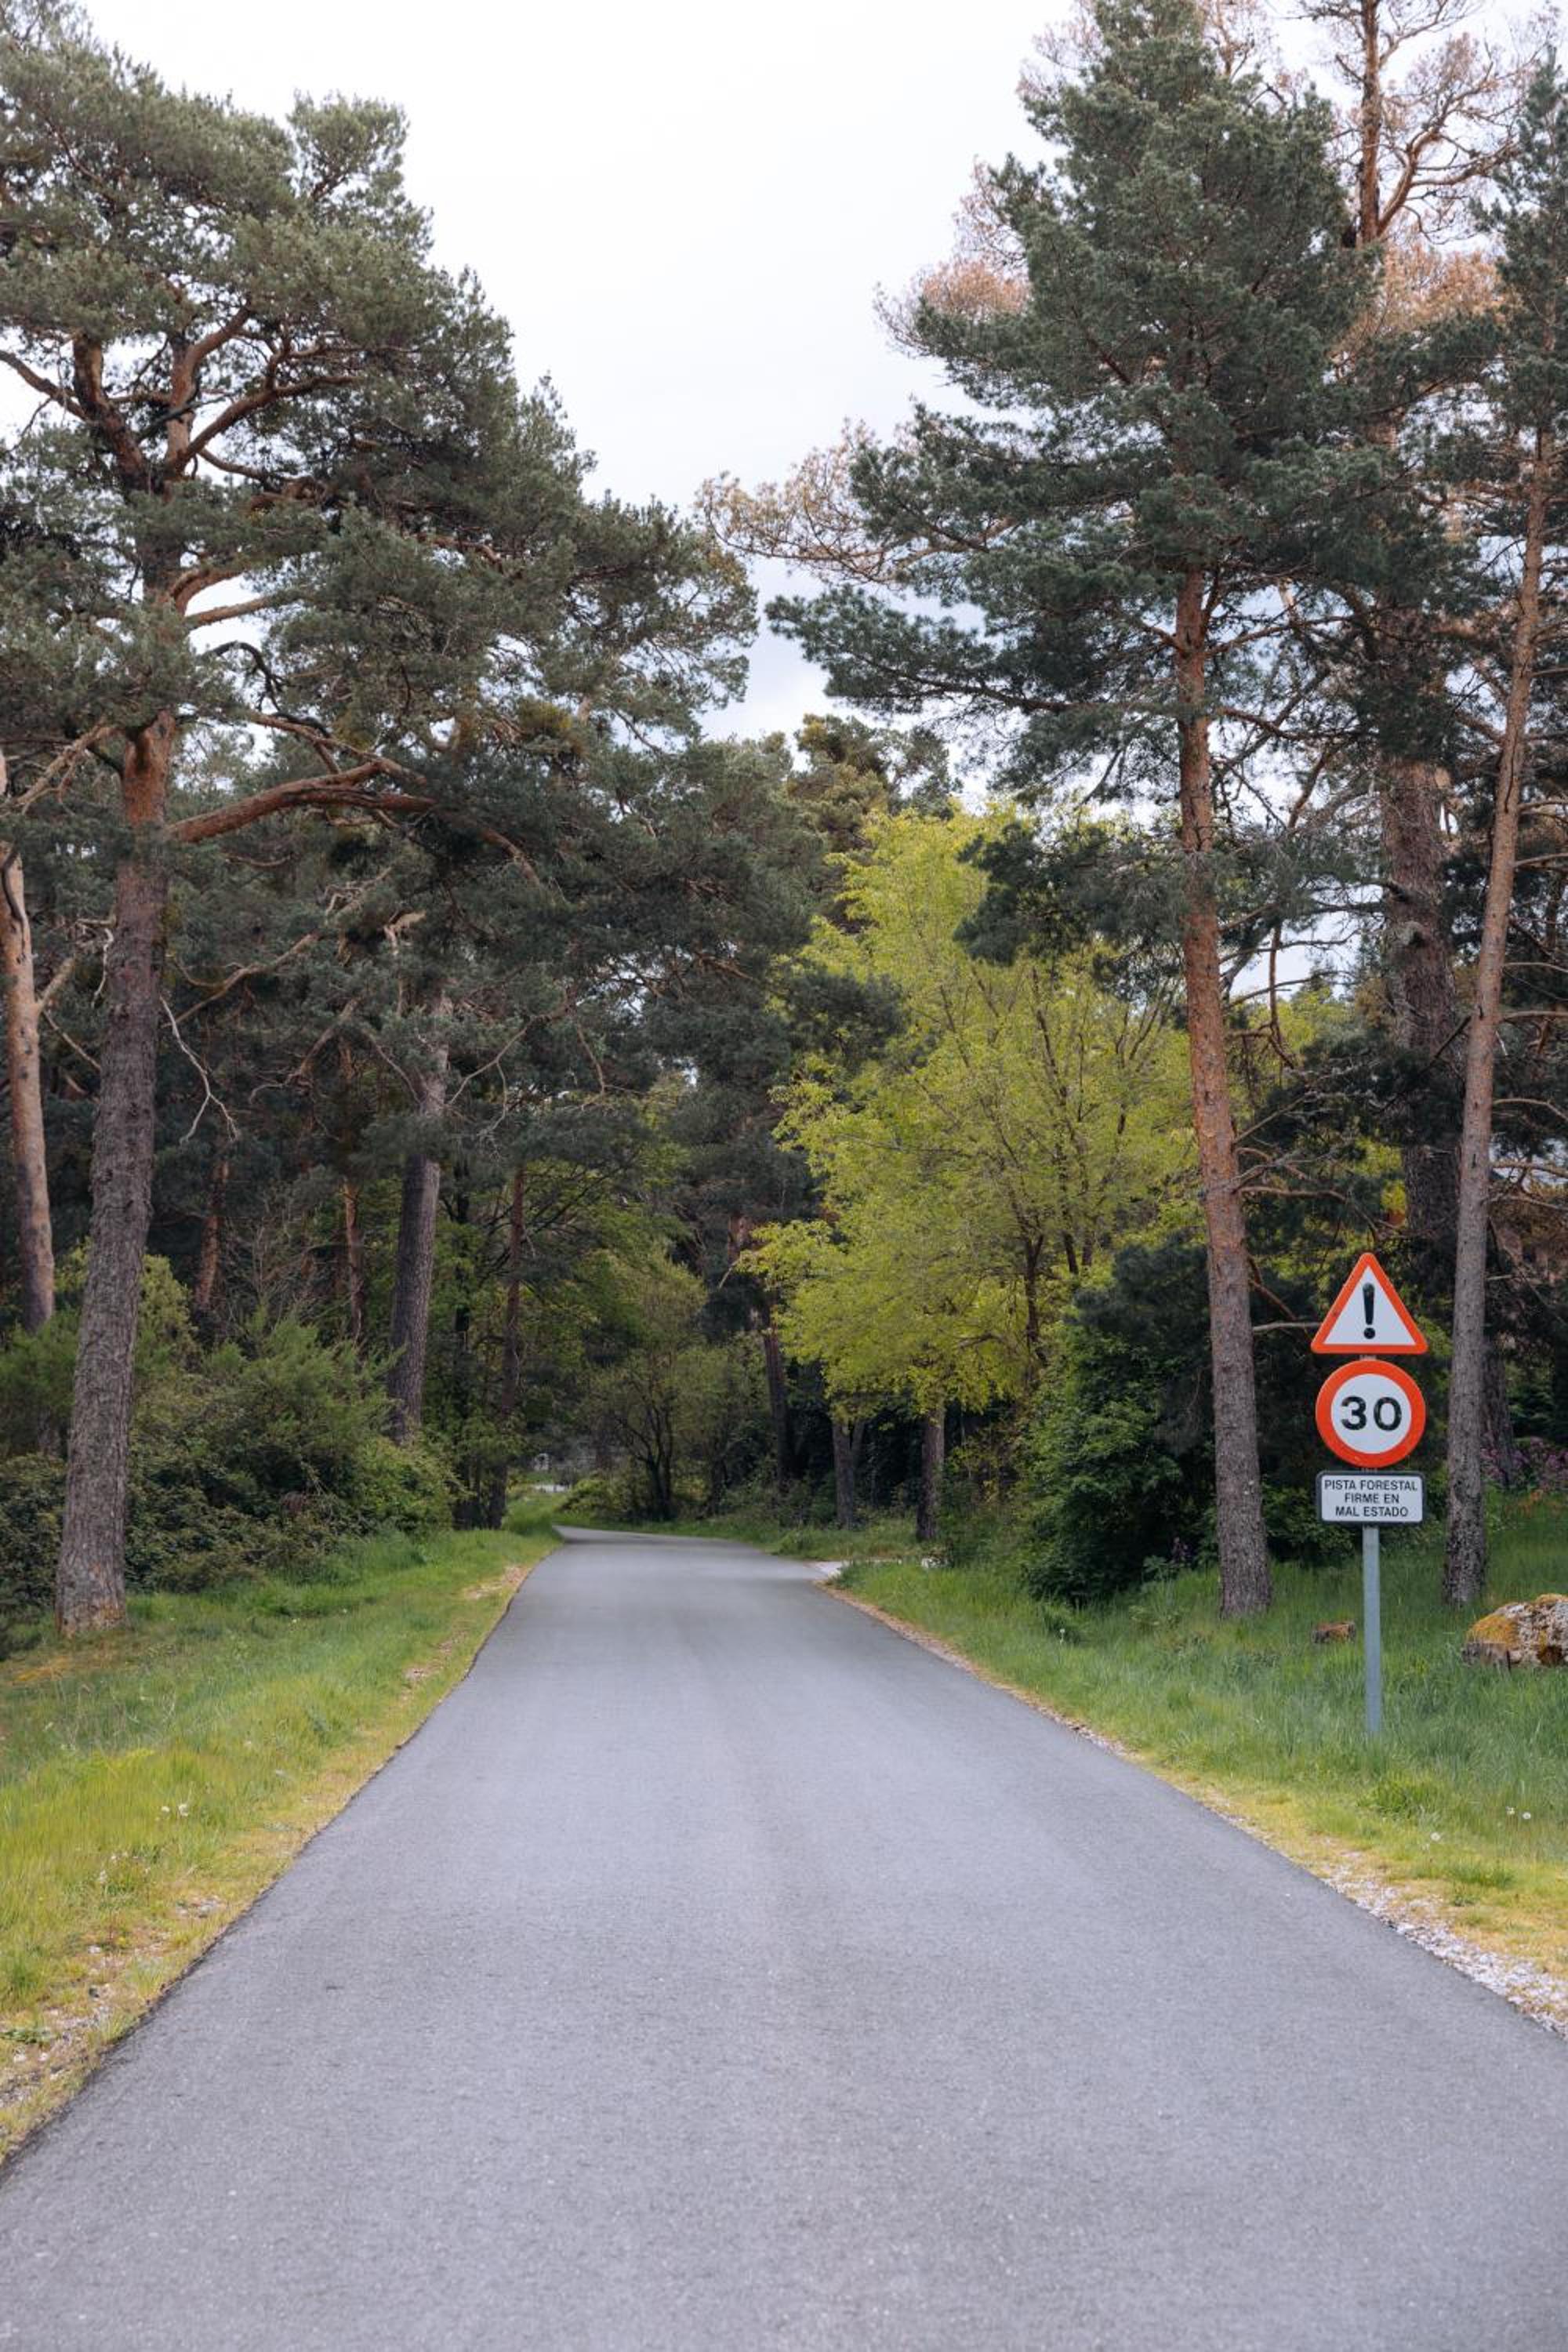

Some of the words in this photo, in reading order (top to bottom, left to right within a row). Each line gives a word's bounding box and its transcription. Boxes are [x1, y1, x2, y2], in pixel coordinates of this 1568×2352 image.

[1341, 1396, 1403, 1432] 30
[1324, 1479, 1356, 1490] PISTA
[1360, 1479, 1418, 1491] FORESTAL
[1345, 1493, 1379, 1504] FIRME
[1384, 1494, 1399, 1504] EN
[1335, 1506, 1359, 1517] MAL
[1363, 1506, 1409, 1517] ESTADO
